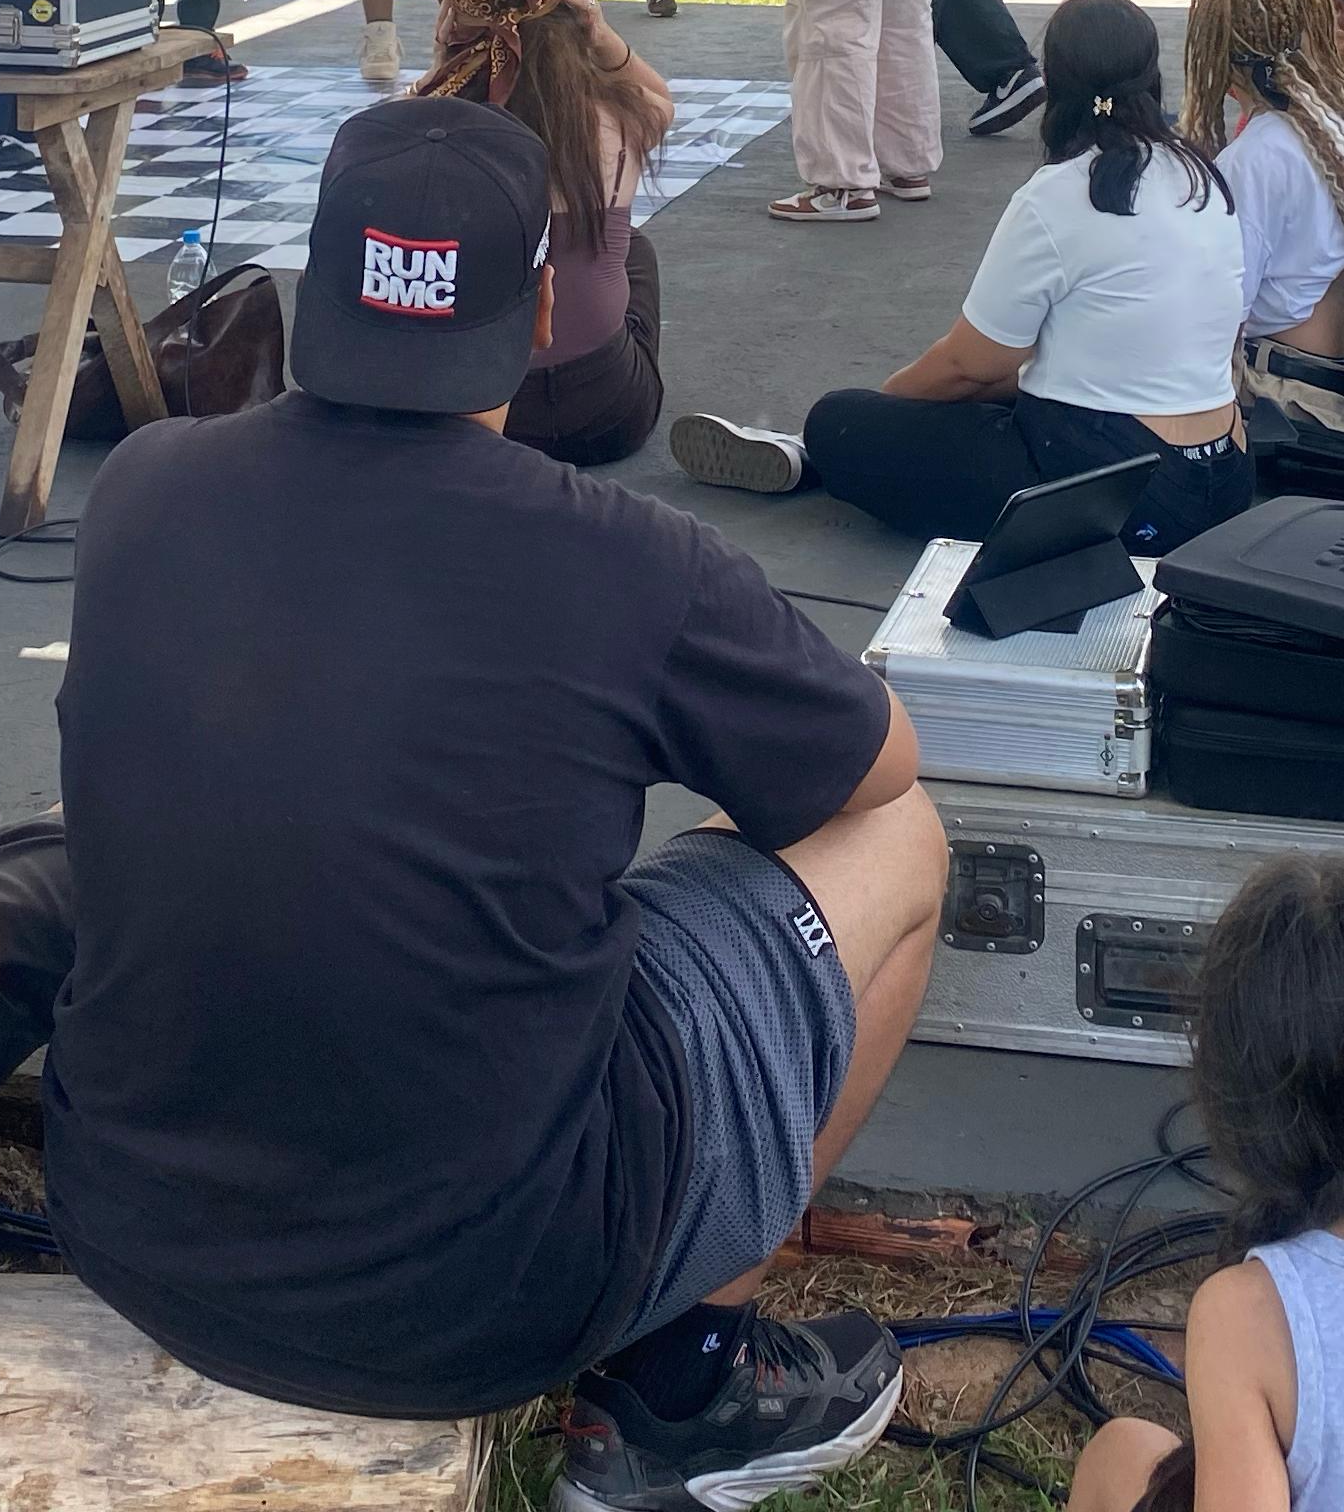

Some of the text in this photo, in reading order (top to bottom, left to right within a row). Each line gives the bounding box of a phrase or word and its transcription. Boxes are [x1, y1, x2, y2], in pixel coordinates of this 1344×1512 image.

[364, 237, 458, 282] RUN
[362, 268, 456, 309] DMC
[1183, 446, 1202, 460] LOVE
